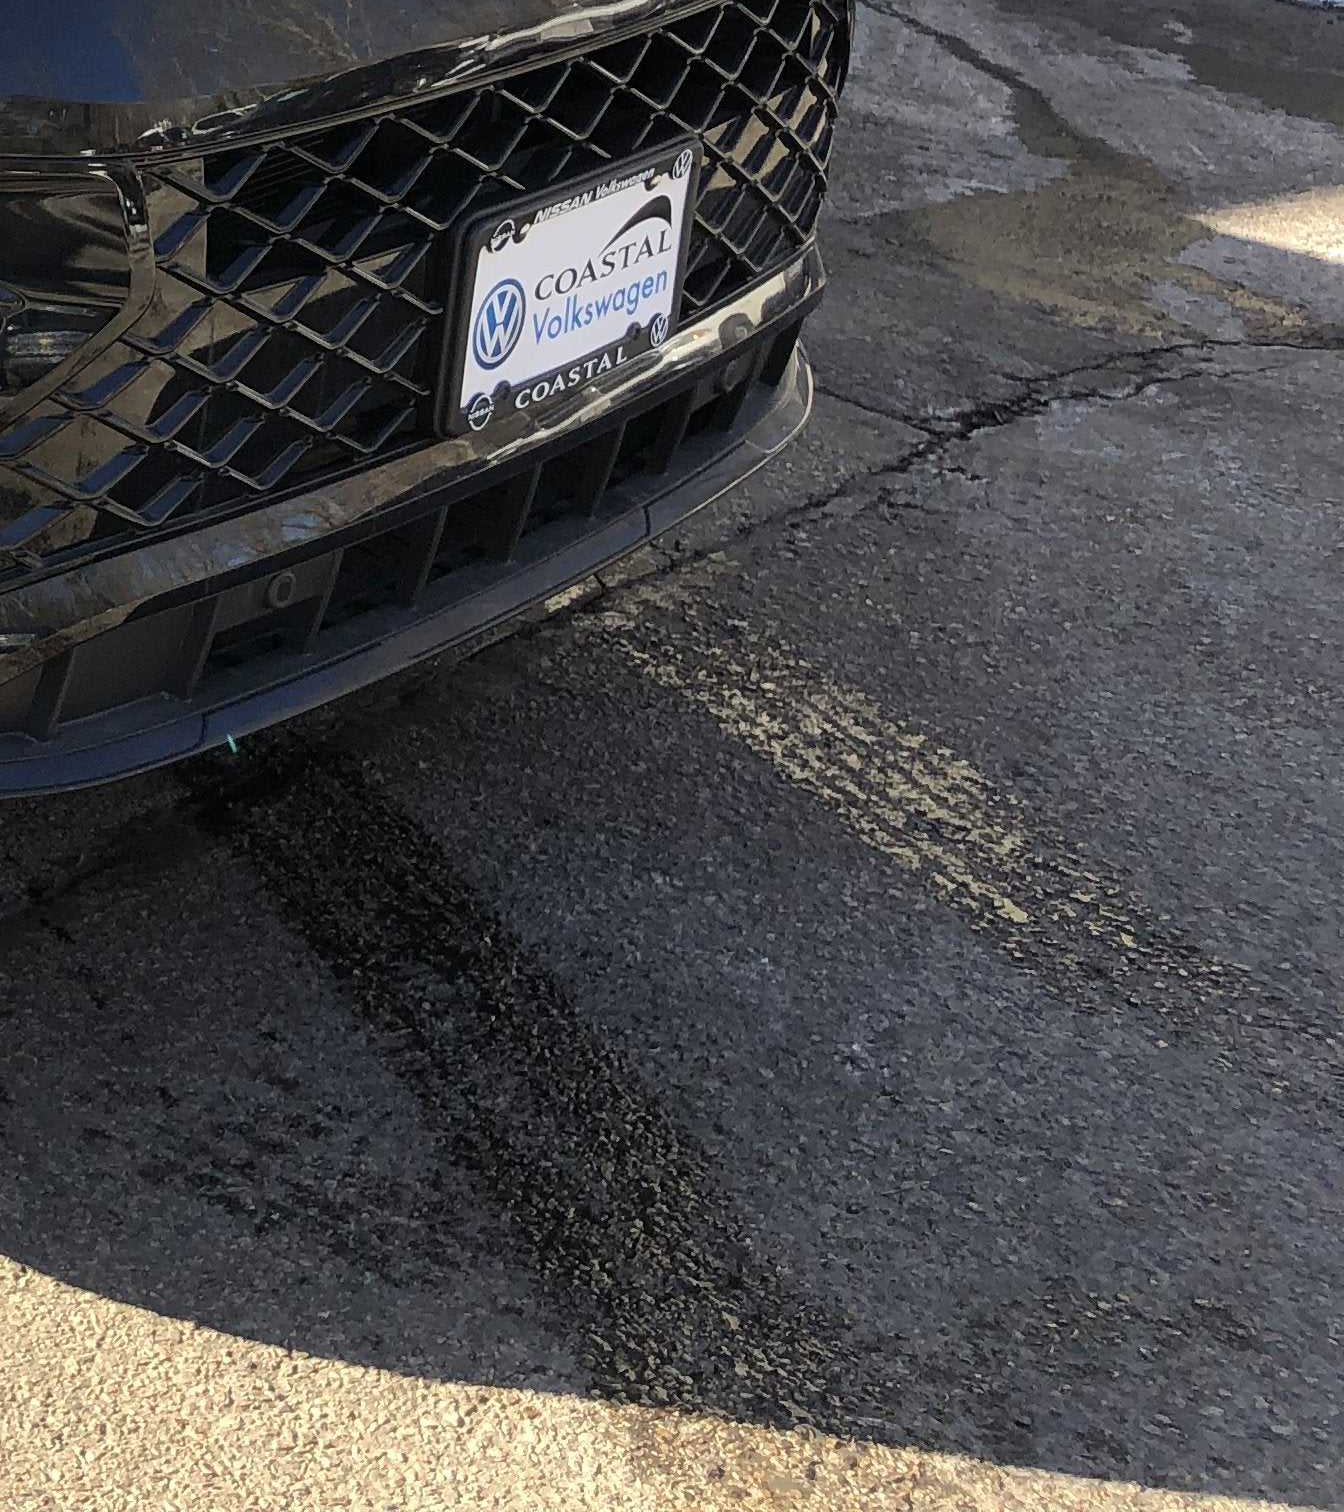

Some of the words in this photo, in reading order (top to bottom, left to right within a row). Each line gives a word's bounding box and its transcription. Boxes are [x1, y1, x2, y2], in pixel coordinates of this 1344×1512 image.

[534, 191, 593, 224] NISSAN
[535, 230, 672, 300] COASTAL
[533, 269, 668, 345] Volkswagen
[515, 346, 627, 409] COASTAL
